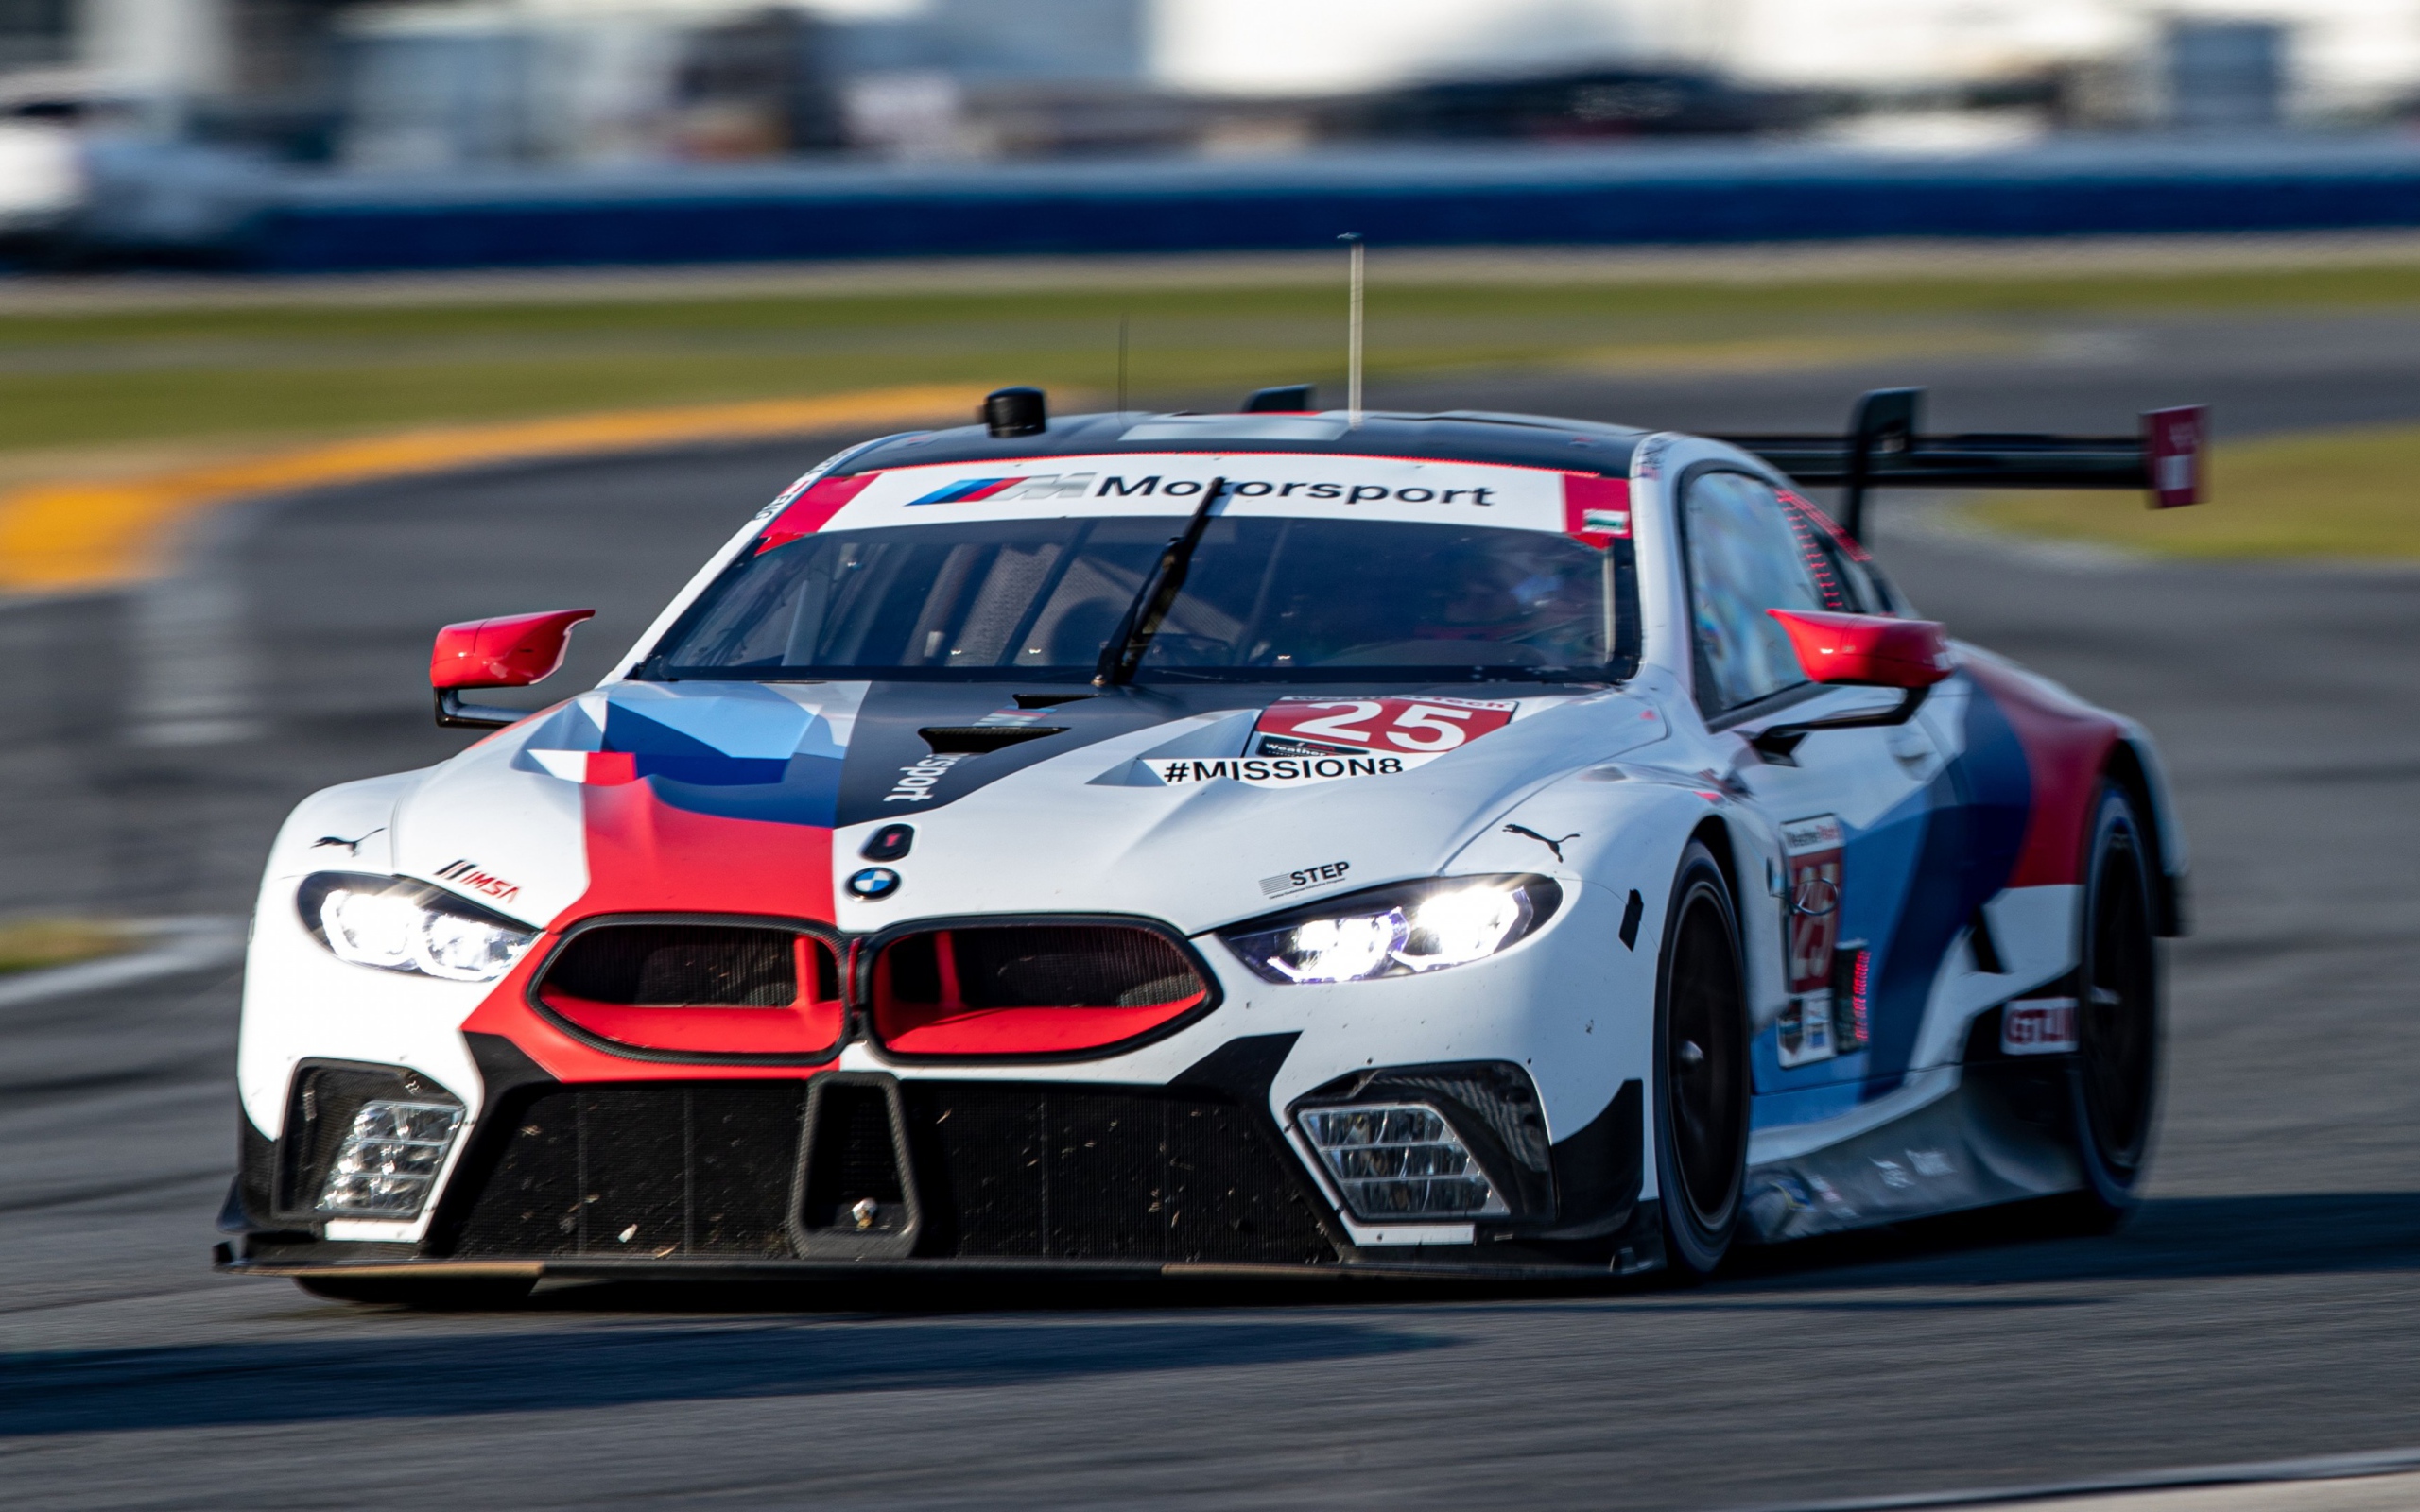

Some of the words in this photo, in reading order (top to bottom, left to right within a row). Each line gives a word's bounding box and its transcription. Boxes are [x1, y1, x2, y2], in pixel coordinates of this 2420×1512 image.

[1290, 700, 1473, 751] 25
[1163, 758, 1404, 782] #MISSION8
[1289, 861, 1350, 886] STEP
